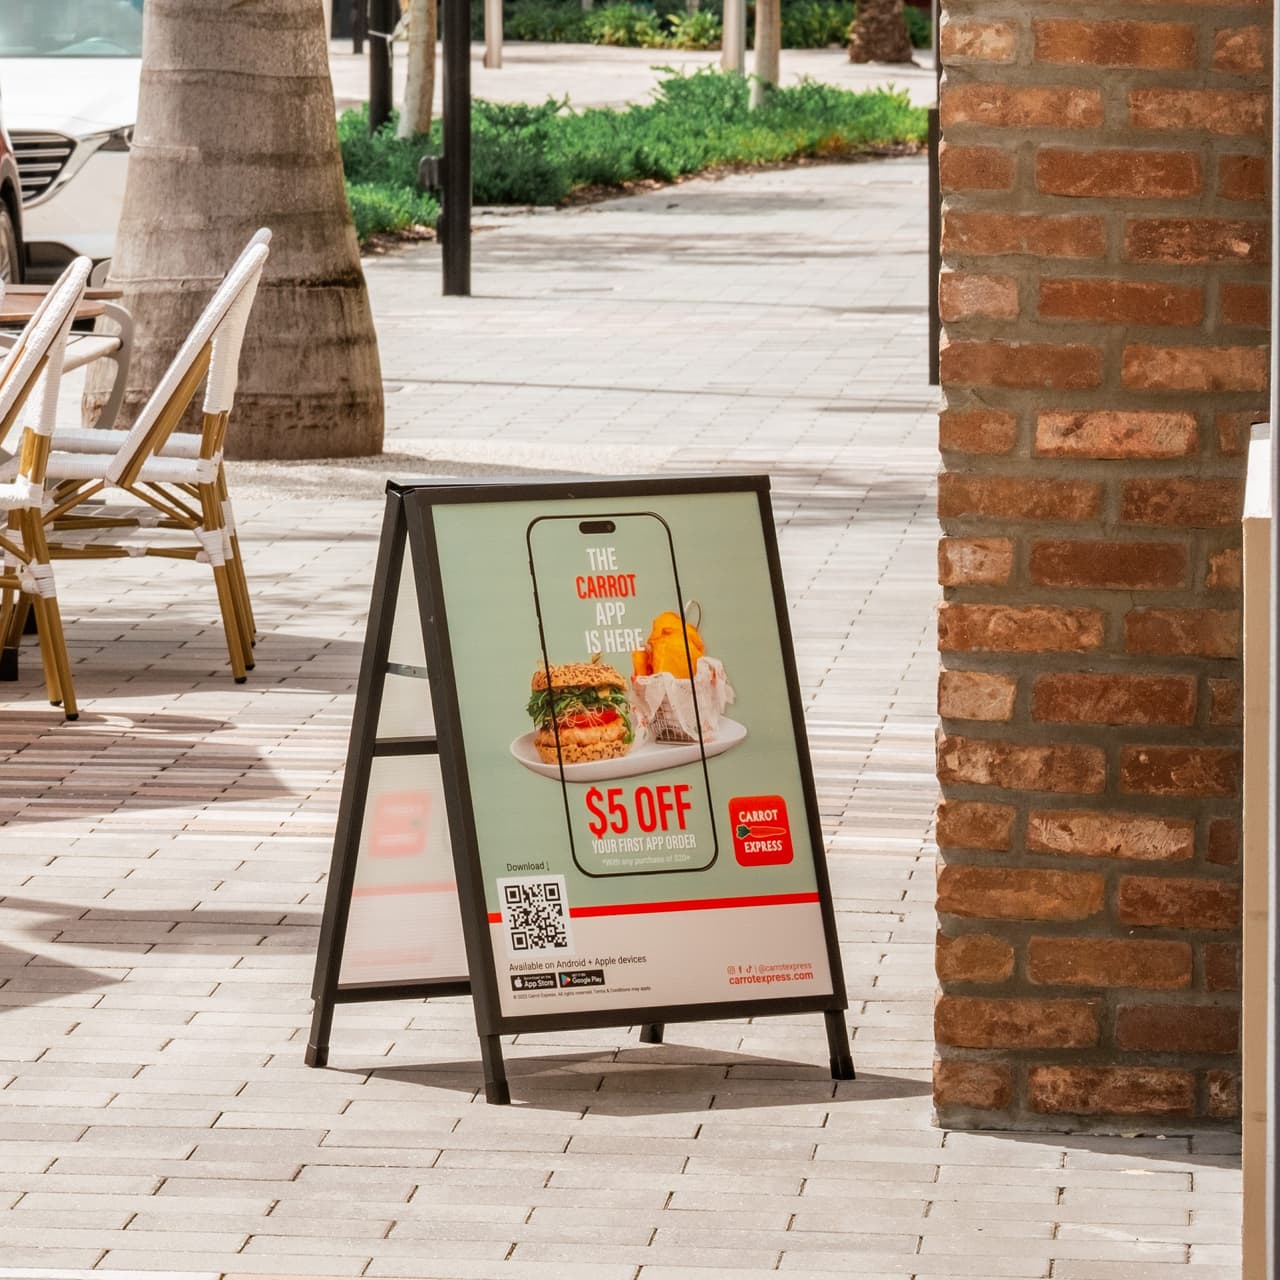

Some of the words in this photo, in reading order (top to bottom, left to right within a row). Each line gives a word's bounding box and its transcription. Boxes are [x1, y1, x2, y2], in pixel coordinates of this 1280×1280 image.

[585, 547, 618, 571] THE
[575, 573, 637, 599] CARROT
[595, 601, 626, 626] APP
[585, 630, 602, 654] IS
[604, 628, 646, 653] HERE
[585, 785, 629, 840] $5
[738, 809, 779, 823] CARROT
[591, 839, 618, 855] YOUR
[619, 837, 645, 853] FIRST
[646, 836, 665, 851] APP
[665, 834, 697, 850] ORDER
[744, 840, 783, 853] EXPRESS
[506, 861, 545, 872] Download
[509, 961, 543, 972] Available
[556, 958, 587, 969] Android
[594, 957, 617, 968] Apple
[618, 955, 647, 965] devices
[524, 981, 537, 989] App
[538, 979, 554, 987] Store
[572, 976, 591, 984] Google
[592, 975, 603, 983] Play
[729, 971, 814, 985] carrotexpress.com
